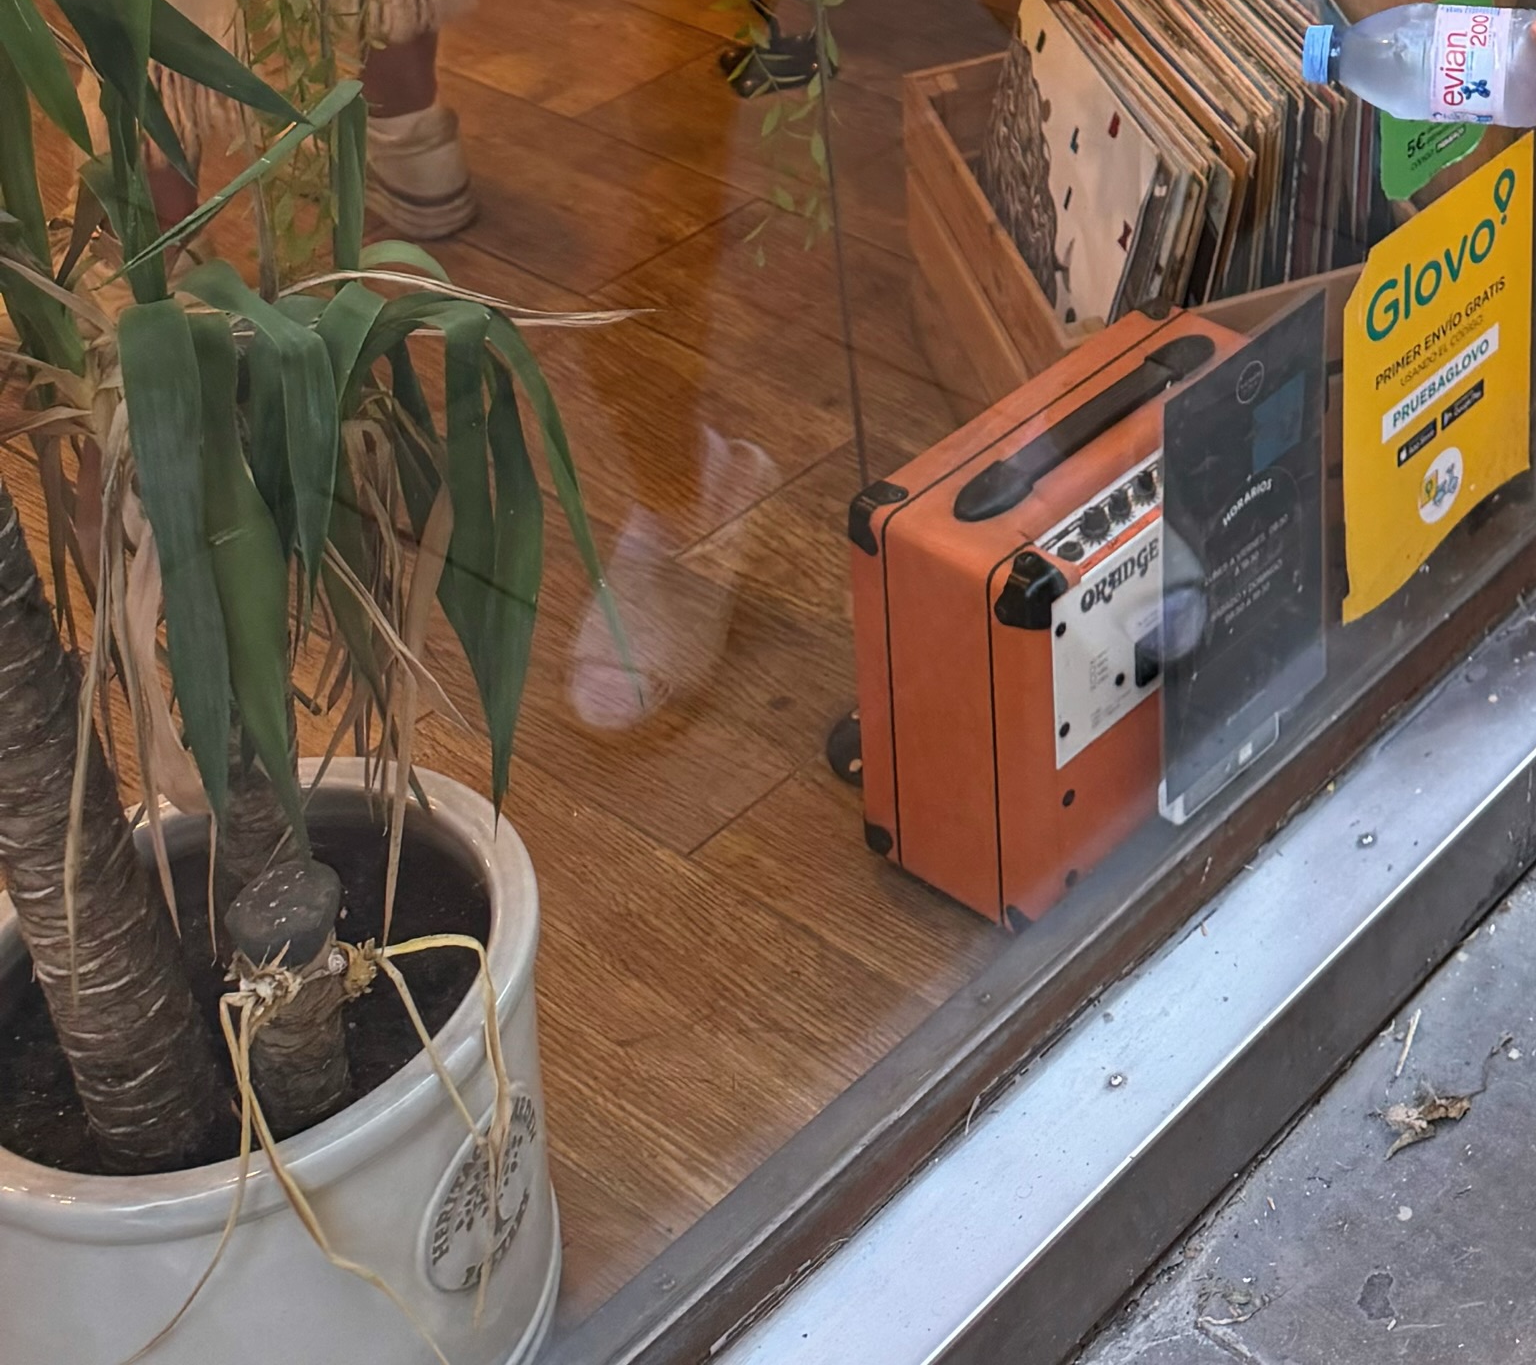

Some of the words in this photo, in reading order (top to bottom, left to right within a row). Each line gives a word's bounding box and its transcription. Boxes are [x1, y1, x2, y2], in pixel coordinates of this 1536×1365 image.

[1440, 31, 1469, 106] evian
[1469, 15, 1490, 47] 200
[1366, 219, 1495, 341] Glovo
[1375, 344, 1421, 390] PRIMER
[1424, 312, 1462, 351] ENVÍO
[1465, 276, 1506, 318] GRATIS
[1392, 339, 1489, 427] PRUEBAGLOVO
[1222, 478, 1272, 527] HORARIOS
[1080, 537, 1160, 613] ORANGE
